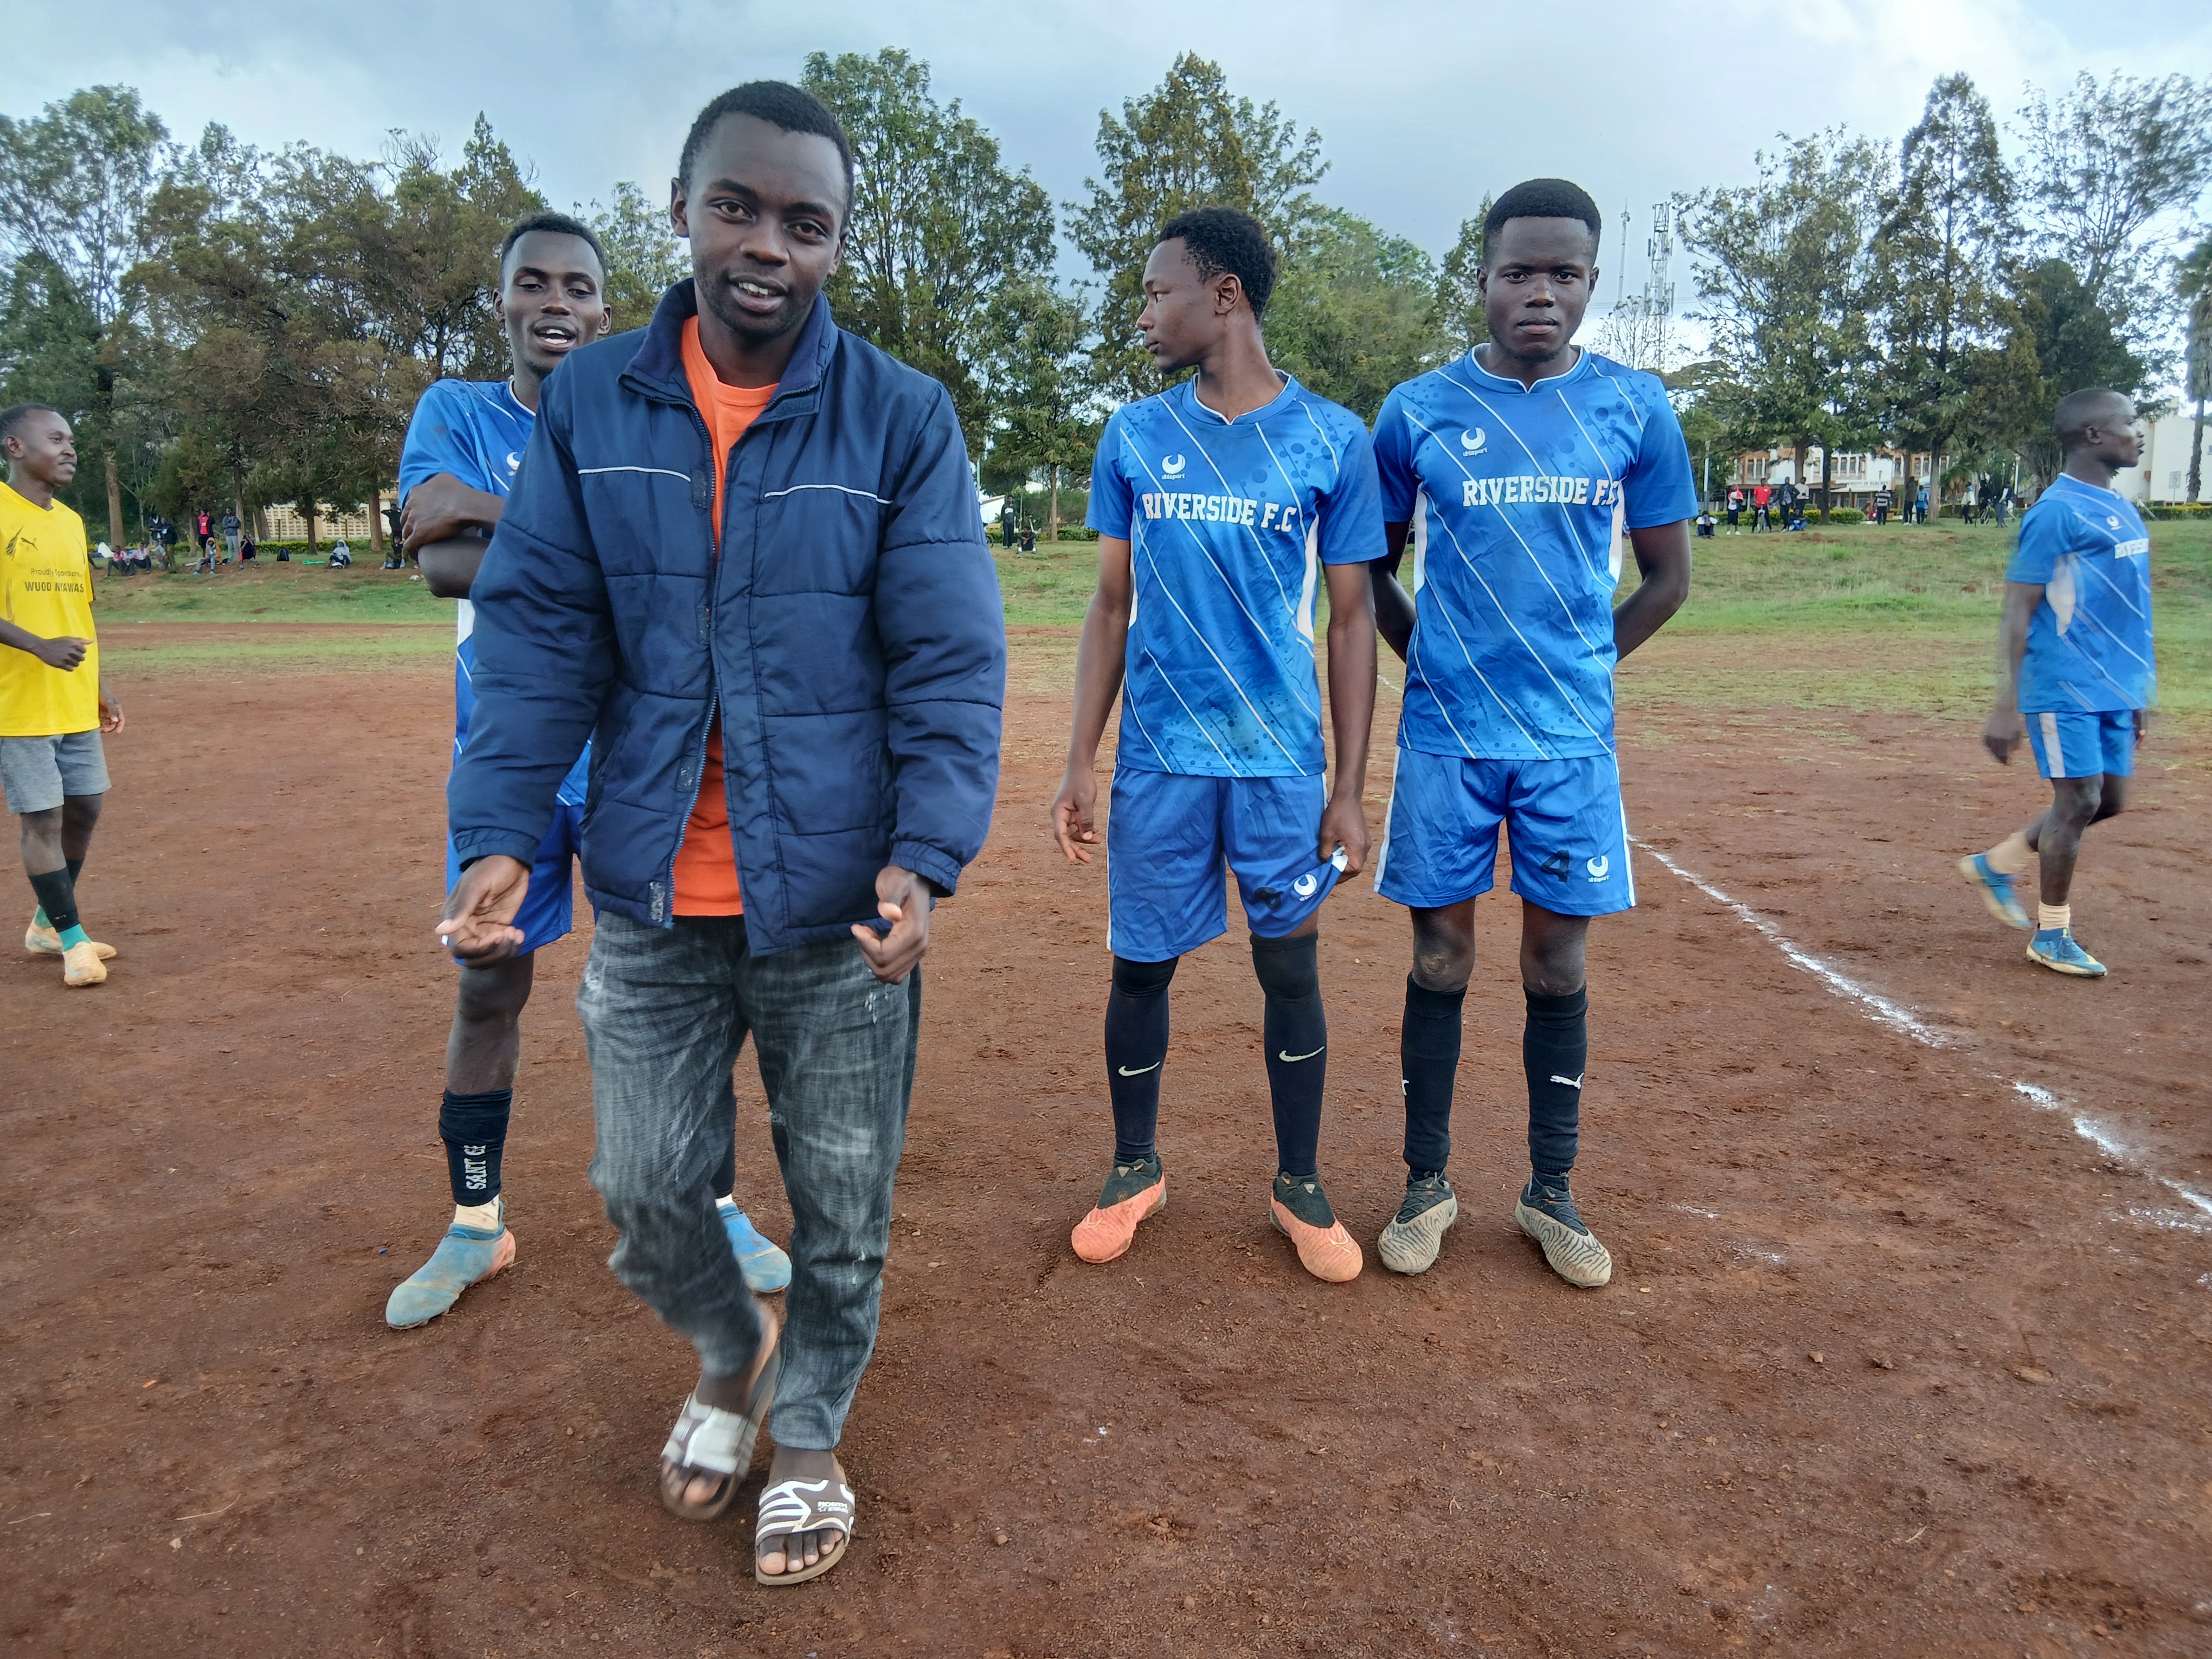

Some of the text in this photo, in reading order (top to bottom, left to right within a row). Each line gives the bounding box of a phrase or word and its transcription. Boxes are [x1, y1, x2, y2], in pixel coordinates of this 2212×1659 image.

[1462, 475, 1590, 507] RIVERSIDE
[1142, 492, 1298, 532] RIVERSIDE F.C
[24, 582, 52, 591] WUOD
[30, 568, 54, 577] Proudly
[1541, 850, 1572, 883] 4
